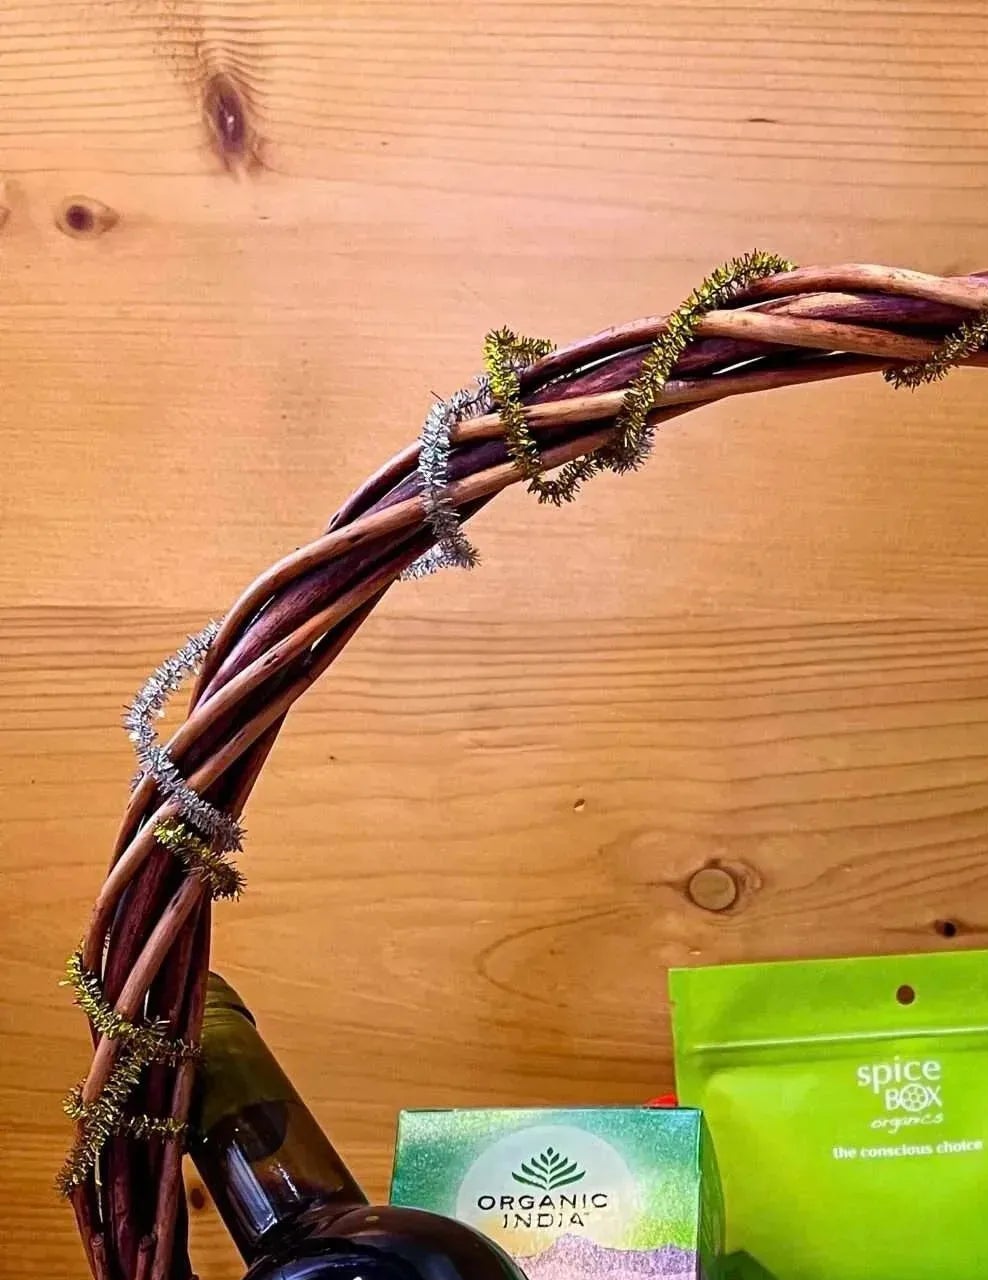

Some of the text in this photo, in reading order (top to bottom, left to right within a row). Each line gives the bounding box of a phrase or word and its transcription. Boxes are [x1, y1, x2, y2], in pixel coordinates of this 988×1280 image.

[857, 1056, 941, 1094] spice
[885, 1082, 942, 1111] BOX
[870, 1113, 943, 1134] organics
[833, 1140, 983, 1160] the conscious choice
[477, 1194, 608, 1210] ORGANIC
[503, 1213, 585, 1228] INDIA
